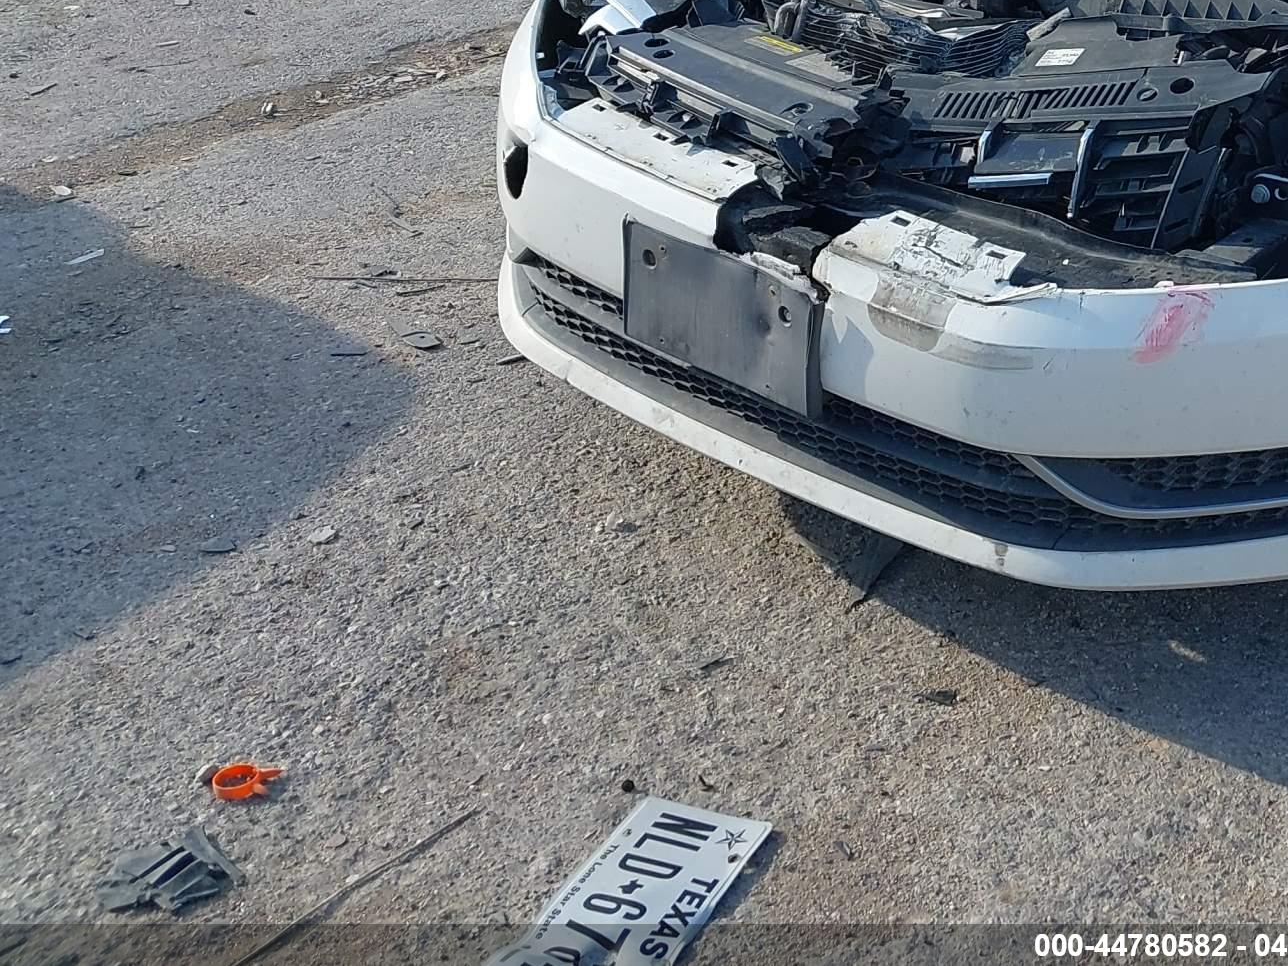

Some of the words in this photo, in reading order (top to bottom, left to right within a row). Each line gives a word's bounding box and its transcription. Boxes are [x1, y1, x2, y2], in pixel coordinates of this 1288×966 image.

[600, 844, 619, 859] The
[578, 862, 603, 884] Lone
[560, 886, 581, 908] Star
[535, 909, 562, 940] State
[639, 877, 720, 960] TEXAS
